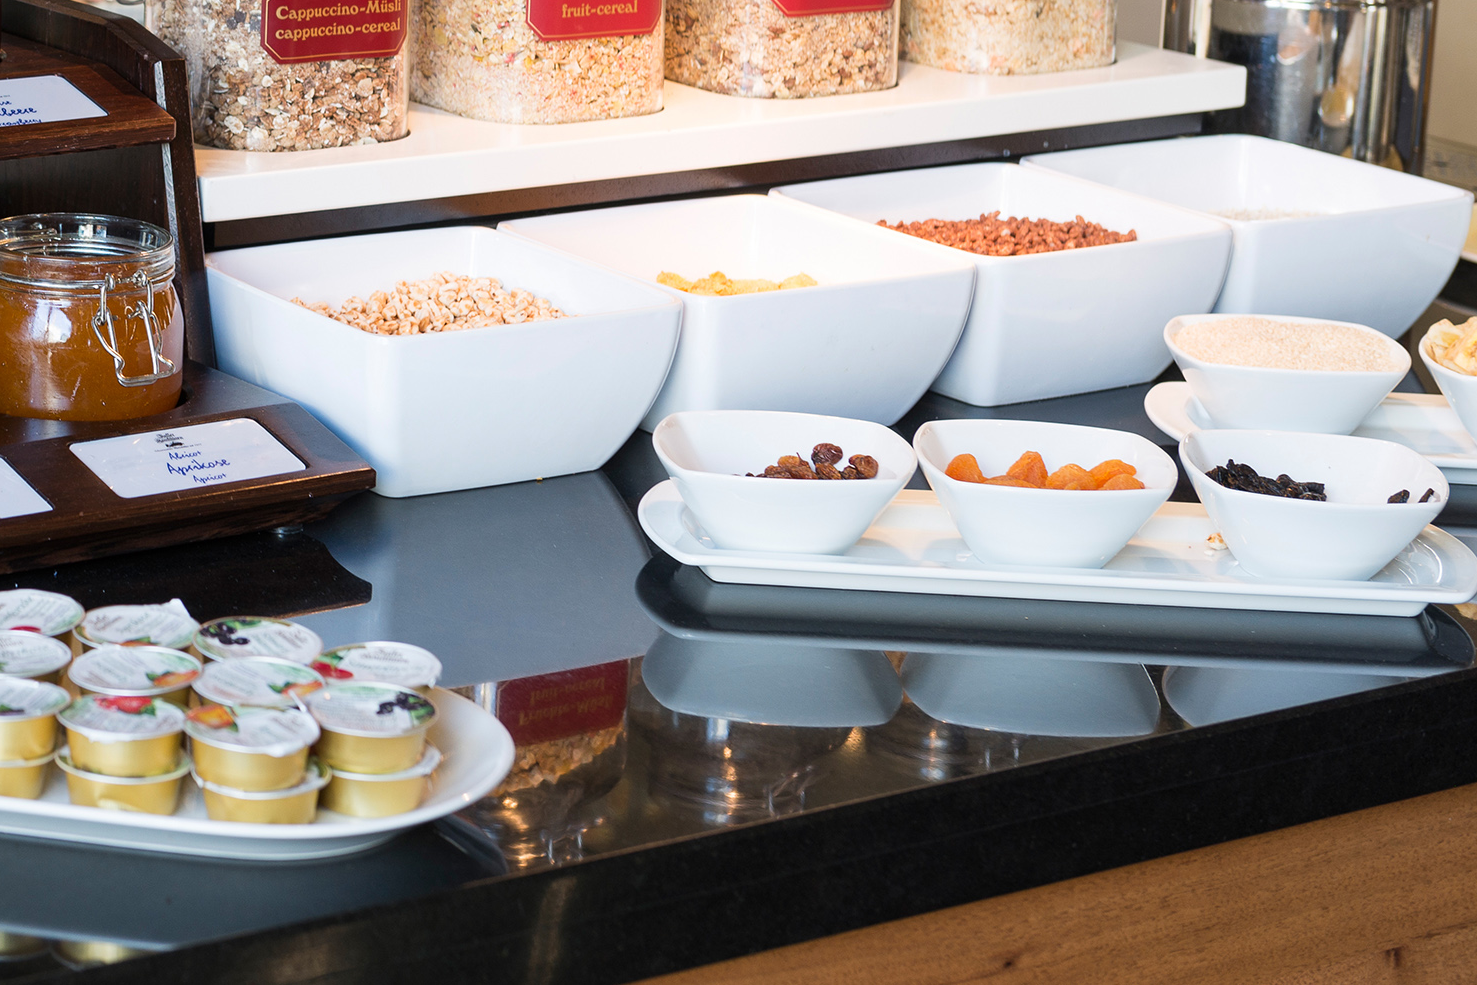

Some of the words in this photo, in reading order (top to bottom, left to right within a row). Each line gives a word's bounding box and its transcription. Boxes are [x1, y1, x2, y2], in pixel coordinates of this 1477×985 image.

[561, 0, 638, 19] fruit-cereal
[275, 18, 401, 42] cappuccino-cereal
[168, 450, 202, 461] Abricot
[166, 458, 231, 476] Aprikose
[192, 472, 227, 485] Apricot
